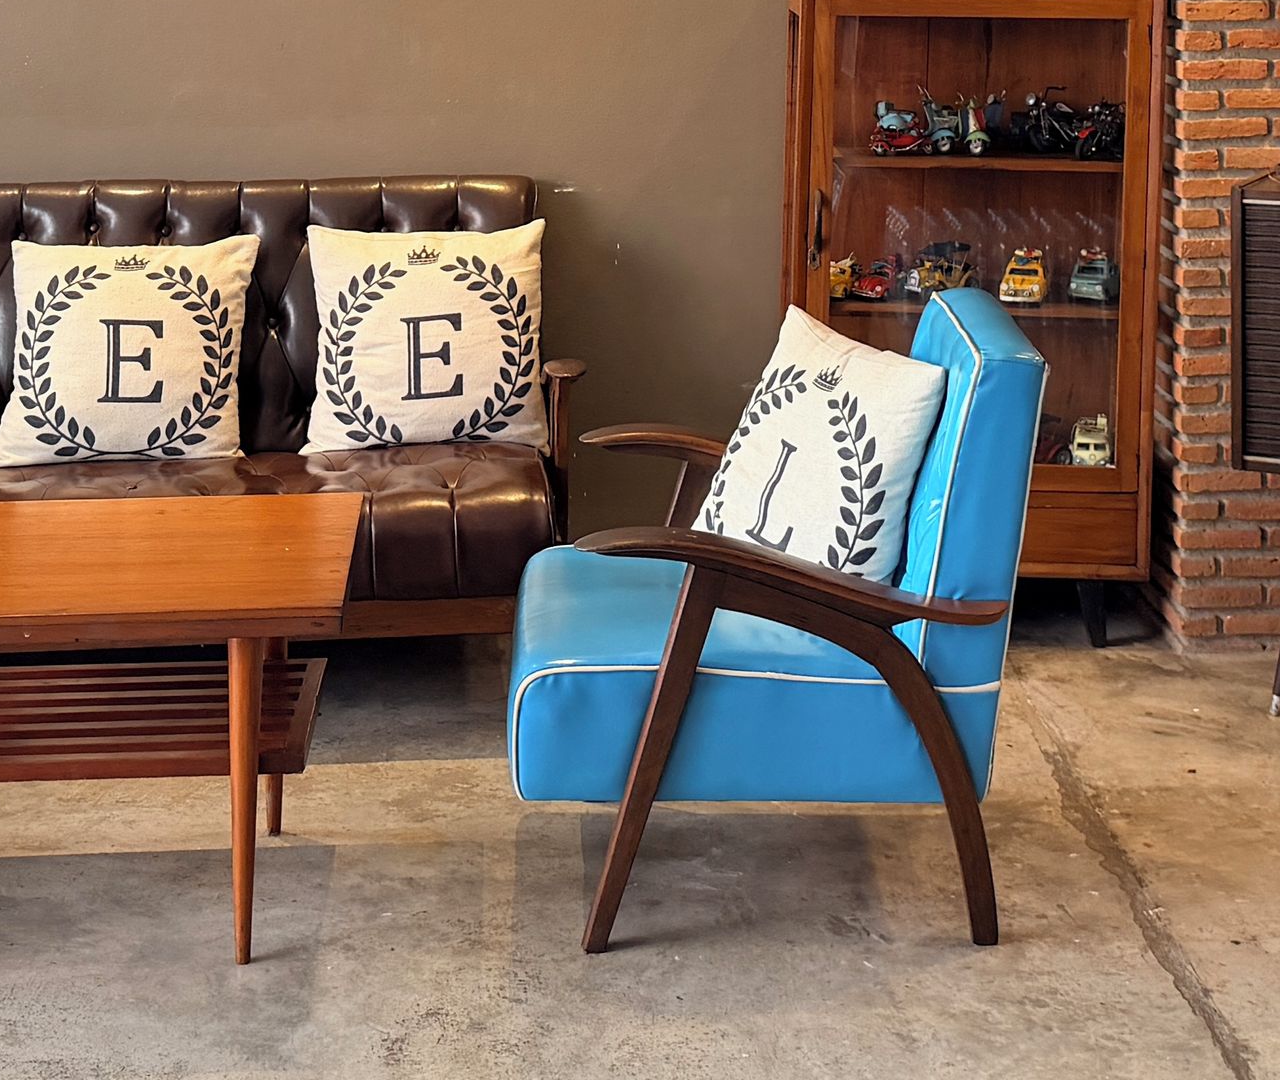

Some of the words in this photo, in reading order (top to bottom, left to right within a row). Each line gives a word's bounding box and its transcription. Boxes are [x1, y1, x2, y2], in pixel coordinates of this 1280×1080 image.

[97, 317, 164, 405] E
[399, 311, 465, 403] E
[745, 438, 797, 553] L
